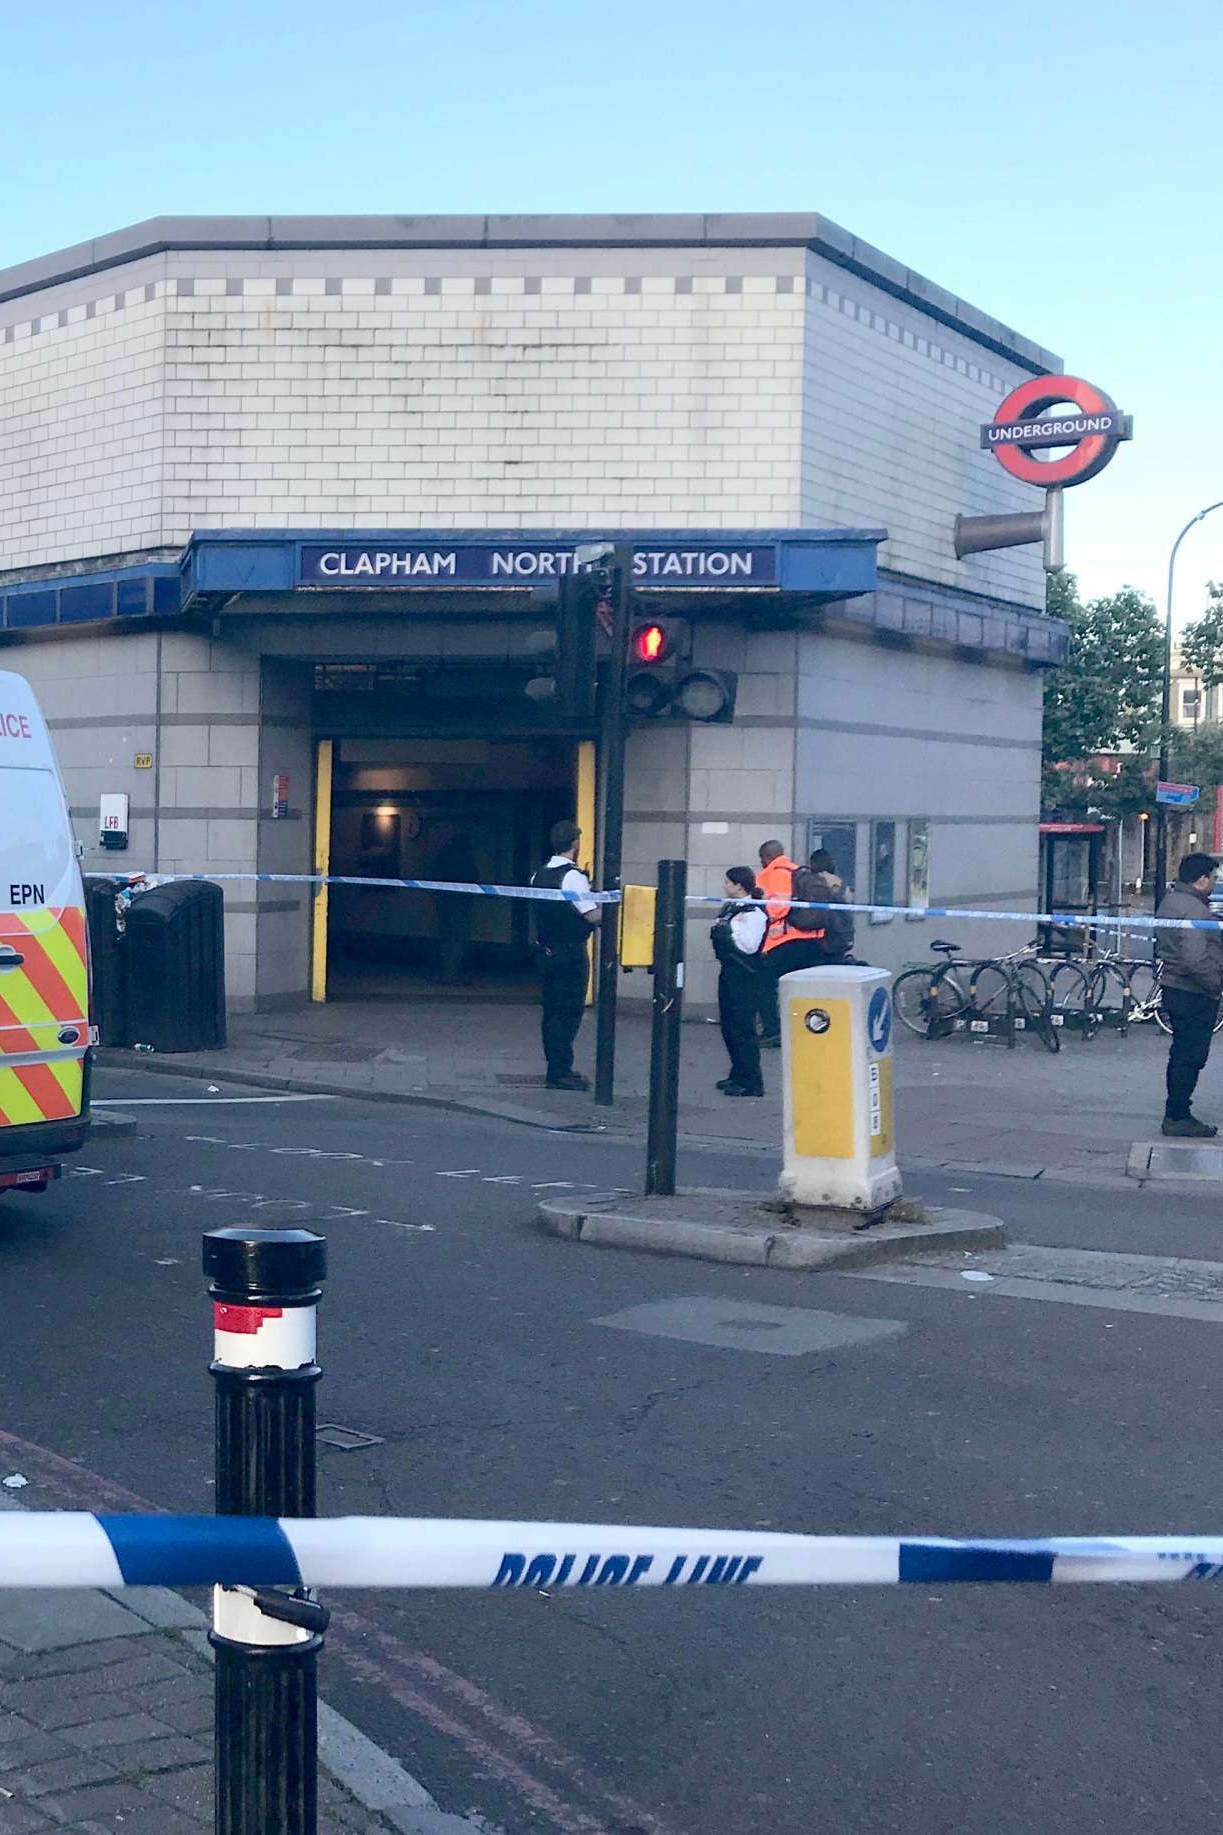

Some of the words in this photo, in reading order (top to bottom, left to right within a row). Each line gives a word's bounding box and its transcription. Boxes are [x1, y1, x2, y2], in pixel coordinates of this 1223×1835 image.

[988, 416, 1112, 441] UNDERGROUND
[319, 552, 456, 575] CLAPHAM
[633, 552, 753, 575] STATION
[136, 755, 151, 766] RVP
[104, 816, 119, 829] LFB
[9, 884, 45, 904] EPN
